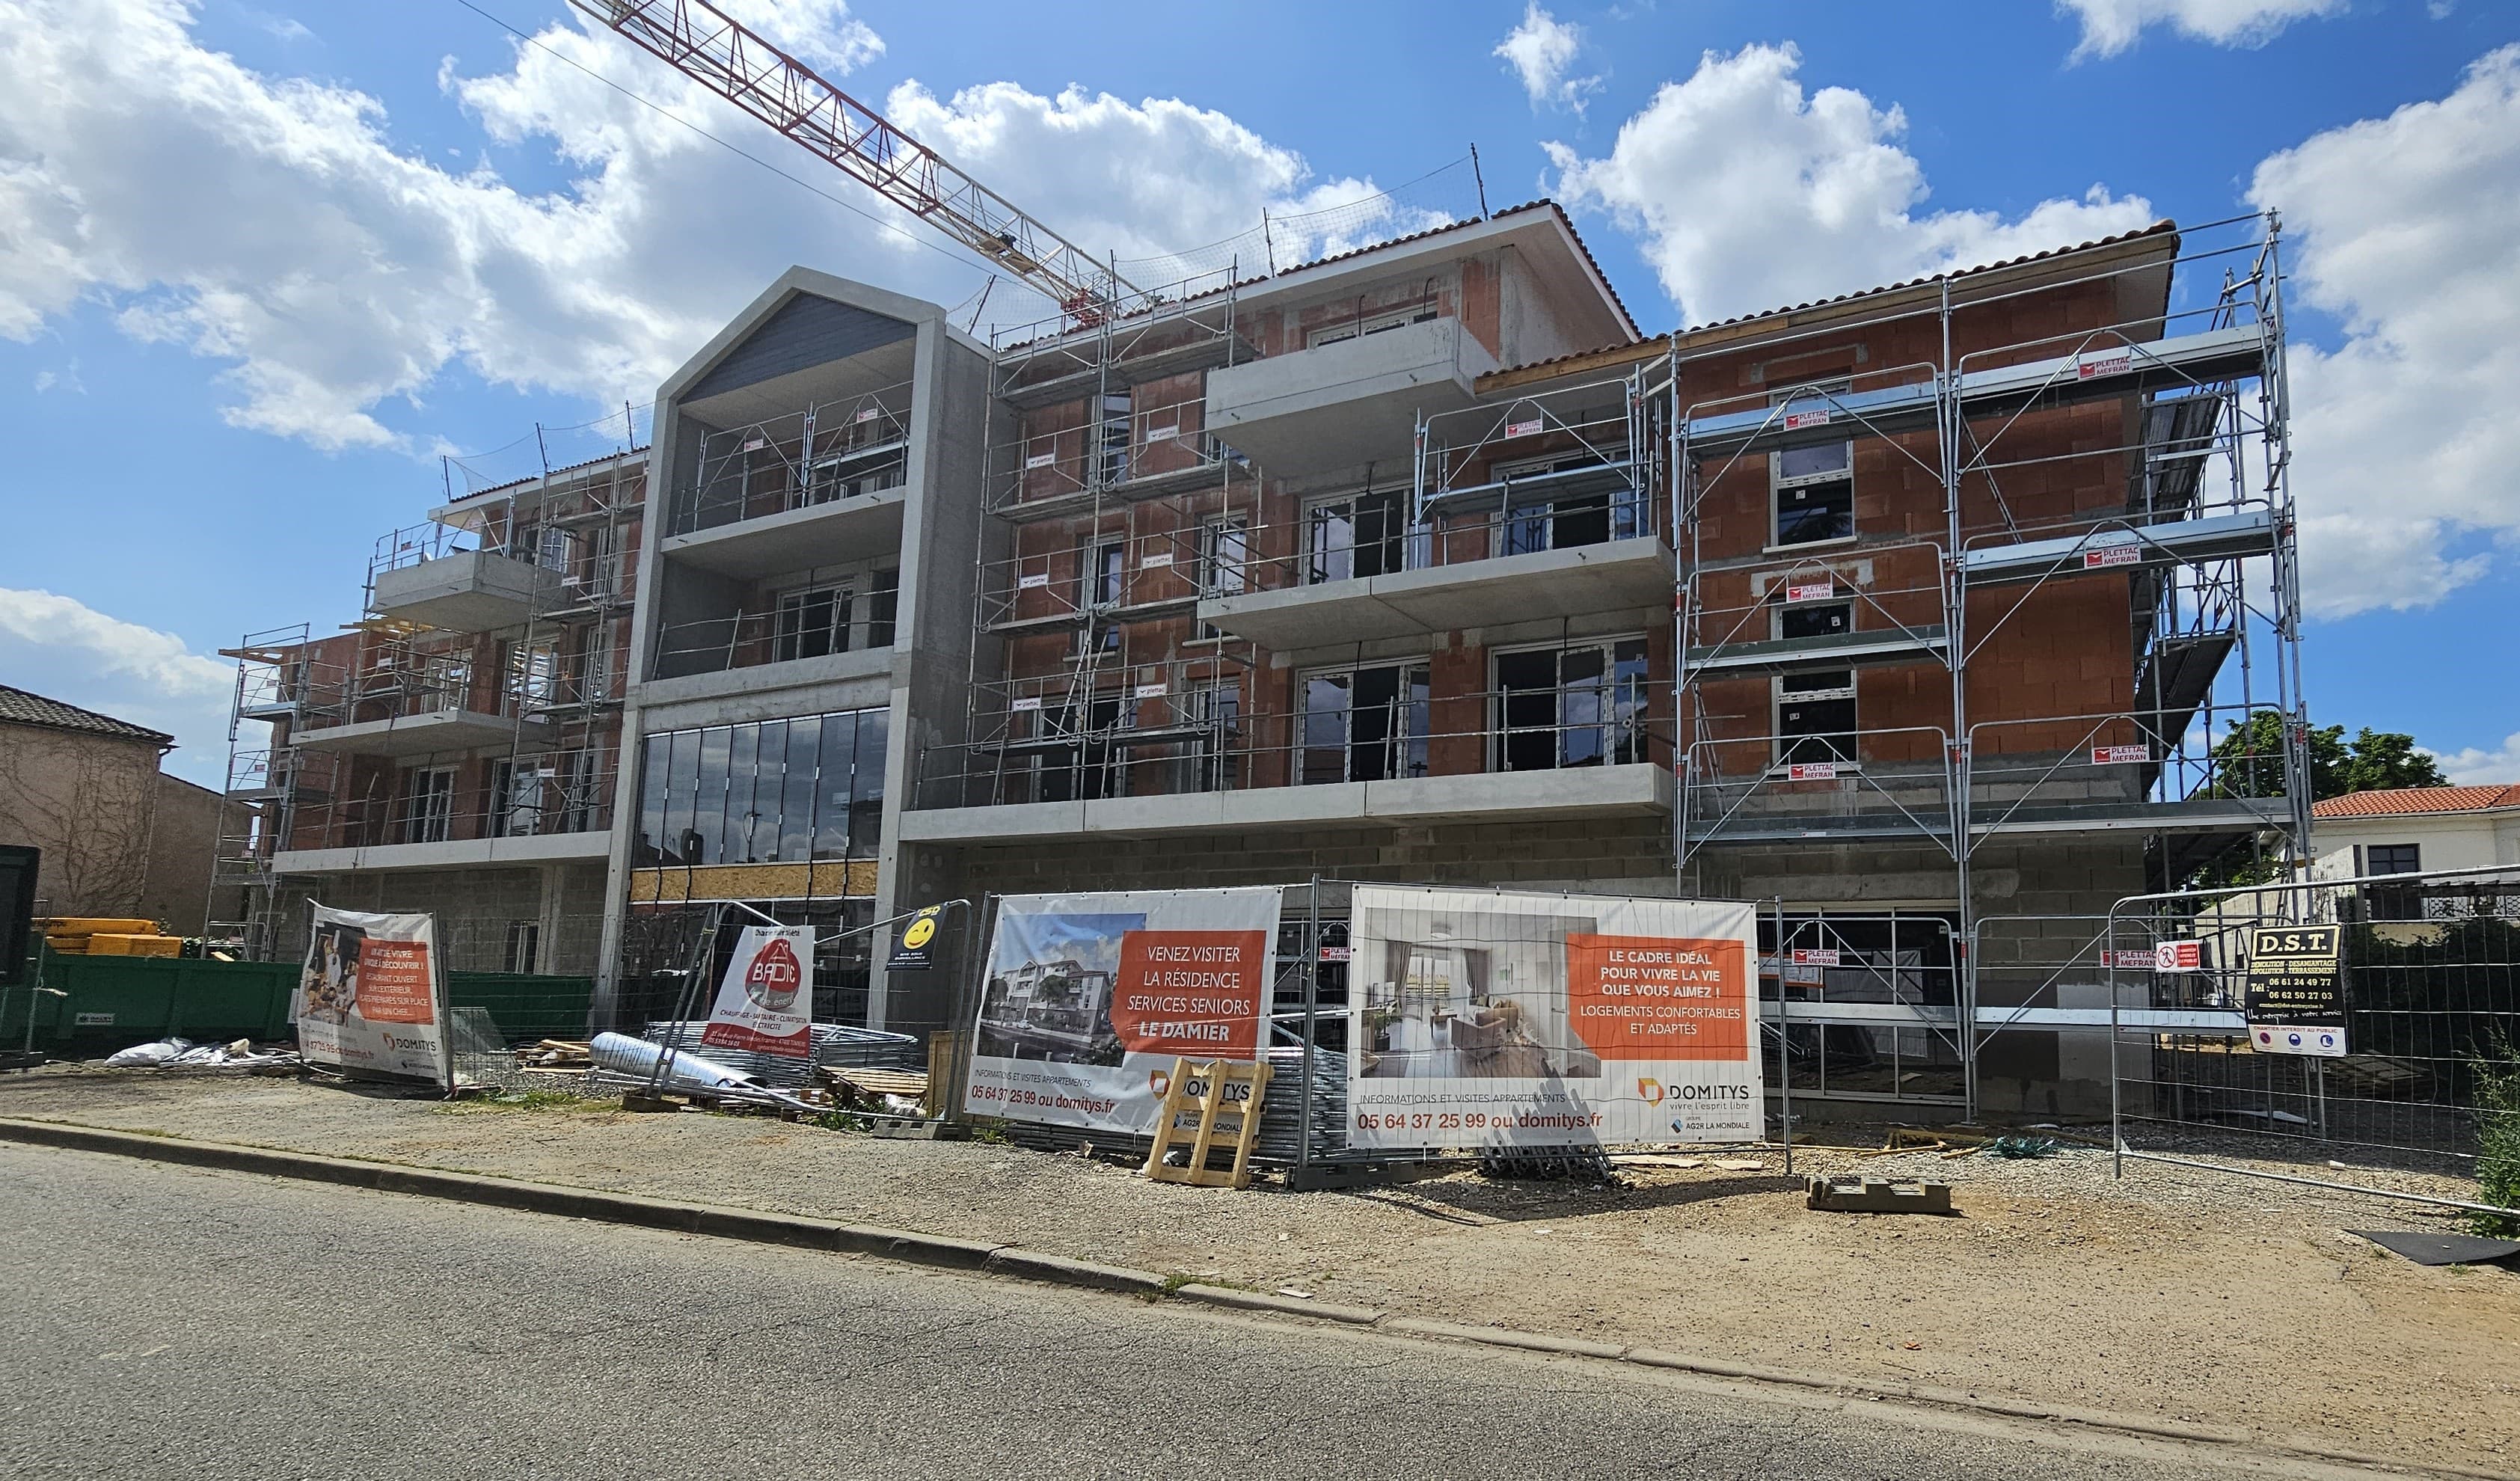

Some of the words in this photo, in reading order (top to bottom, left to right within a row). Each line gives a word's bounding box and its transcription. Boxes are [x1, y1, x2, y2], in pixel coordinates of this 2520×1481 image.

[2096, 355, 2130, 367] PLETTAC
[2097, 365, 2130, 375] MEFRAN
[1800, 410, 1827, 420] PLETTAC
[1800, 418, 1827, 426] MEFRAN
[2103, 547, 2138, 557] PLETTAC
[2104, 555, 2138, 565] MEFRAN
[1803, 583, 1830, 592] PLETTAC
[2112, 746, 2147, 754] PLETTAC
[2112, 754, 2146, 762] MEFRAN
[2260, 933, 2328, 953] D.S.T.
[1147, 946, 1191, 962] VENEZ
[1192, 946, 1241, 963] VISITER
[1610, 951, 1624, 963] LE
[1628, 951, 1673, 964] CADRE
[1676, 951, 1712, 965] IDÉAL
[752, 963, 796, 984] BADIE
[1144, 971, 1160, 987] LA
[1165, 968, 1241, 989] RÉSIDENCE
[1601, 967, 1638, 981] POUR
[1641, 969, 1679, 981] VIVRE
[1681, 969, 1699, 981] LA
[1701, 970, 1720, 982] VIE
[2269, 978, 2279, 986] 06
[1602, 984, 1631, 996] QUE
[1634, 985, 1670, 996] VOUS
[1673, 987, 1712, 998] AIMEZ
[1716, 988, 1720, 999] !
[1127, 996, 1187, 1013] SERVICES
[1190, 998, 1251, 1016] SENIORS
[1581, 1005, 1653, 1018] LOGEMENTS
[1656, 1007, 1741, 1019] CONFORTABLES
[752, 1014, 776, 1022] SANTAIRE
[1139, 1021, 1159, 1037] LE
[1162, 1022, 1230, 1041] DAMIER
[1631, 1023, 1644, 1034] ET
[1648, 1022, 1697, 1034] ADAPTÉS
[396, 1037, 436, 1052] DOMITYS
[1013, 1073, 1020, 1081] ET
[1020, 1073, 1040, 1083] VISITES
[1042, 1076, 1091, 1088] APPARTEMENTS
[1183, 1081, 1251, 1100] OMTYS
[1670, 1085, 1749, 1100] DOMITYS
[972, 1085, 983, 1098] 05
[985, 1087, 996, 1100] 64
[998, 1088, 1008, 1101] 37
[1010, 1089, 1023, 1103] 25
[1025, 1091, 1036, 1105] 99
[1038, 1094, 1052, 1107] ou
[1055, 1094, 1115, 1114] domitys.fr
[1360, 1094, 1436, 1104] INFORMATIONS
[1440, 1094, 1451, 1103] ET
[1455, 1094, 1489, 1103] VISITES
[1492, 1094, 1566, 1103] APPARTEMENTS
[1695, 1101, 1727, 1111] l'esprit
[1730, 1101, 1750, 1110] libre
[1214, 1122, 1243, 1132] ONDIAL
[1358, 1114, 1379, 1129] 05
[1385, 1114, 1406, 1129] 64
[1411, 1114, 1433, 1129] 37
[1438, 1114, 1459, 1129] 25
[1465, 1113, 1486, 1128] 99
[1492, 1116, 1512, 1128] ou
[1518, 1112, 1603, 1131] domitys.fr
